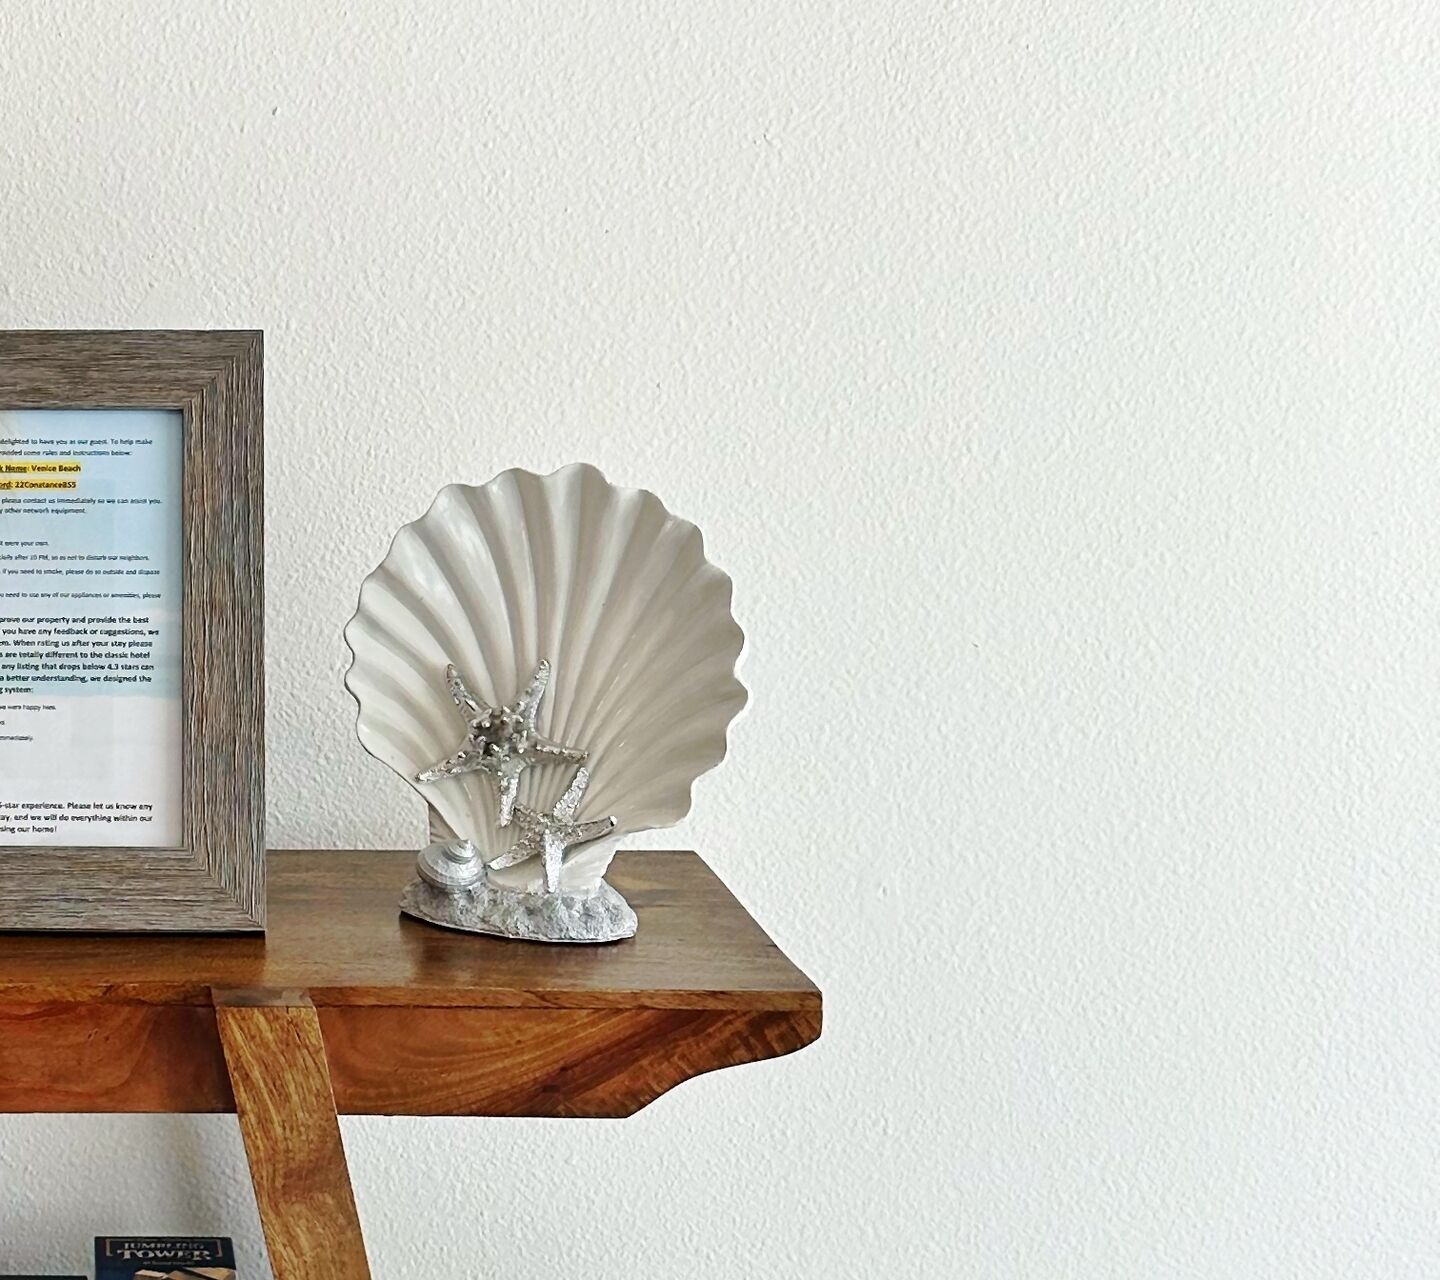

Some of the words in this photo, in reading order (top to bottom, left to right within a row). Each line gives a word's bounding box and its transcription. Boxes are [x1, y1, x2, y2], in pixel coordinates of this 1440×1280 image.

[31, 464, 56, 472] Venice
[58, 464, 81, 472] Beach
[36, 616, 70, 625] property
[87, 616, 116, 625] provide
[132, 616, 150, 624] best
[17, 627, 36, 635] have
[53, 627, 88, 635] feedback
[18, 650, 43, 660] totally
[92, 802, 103, 810] let
[115, 802, 137, 810] know
[13, 813, 28, 821] and
[43, 813, 57, 821] will
[31, 825, 57, 833] home!
[117, 1249, 211, 1260] TOWER
